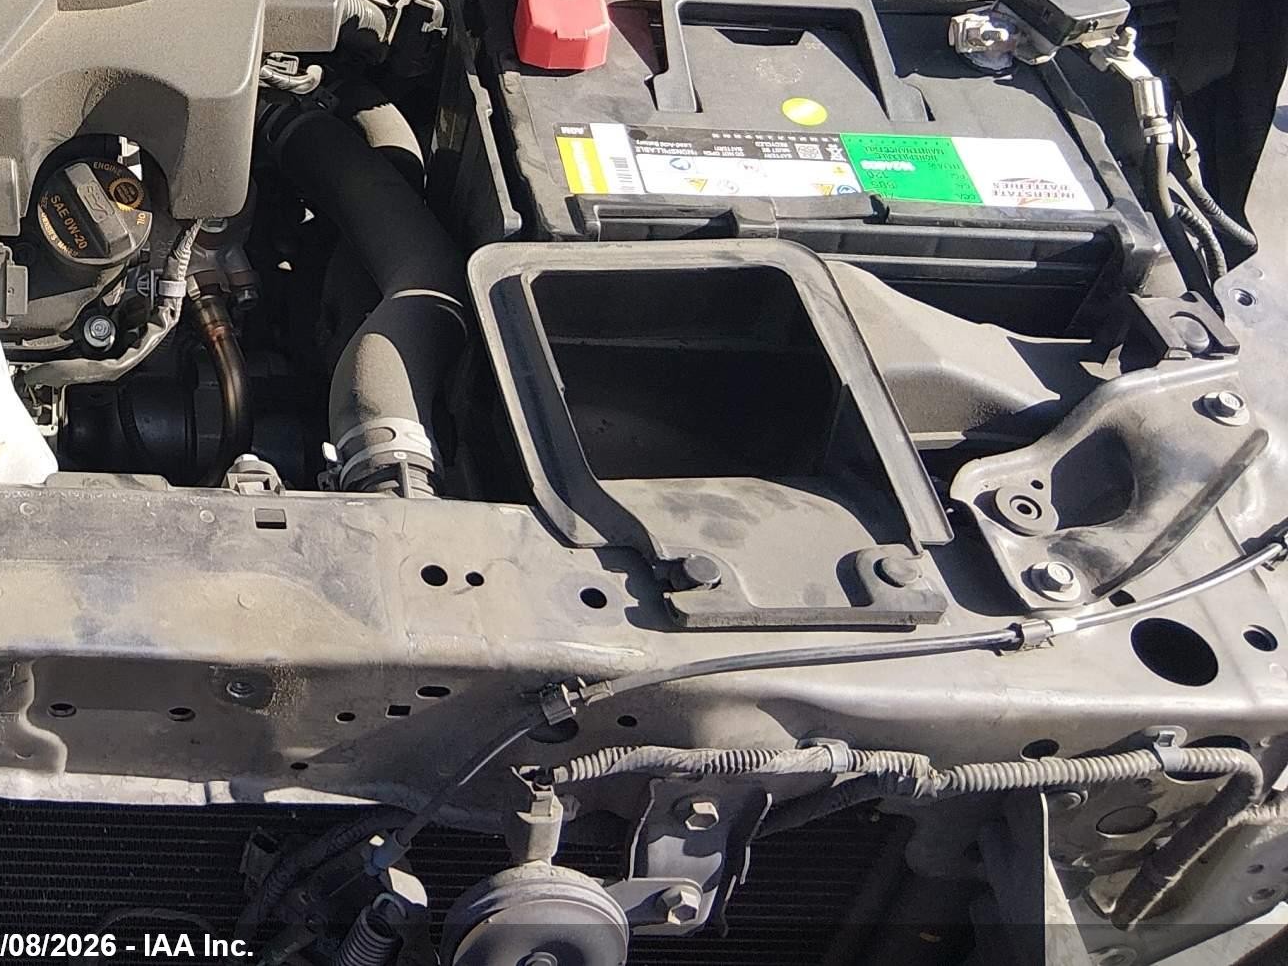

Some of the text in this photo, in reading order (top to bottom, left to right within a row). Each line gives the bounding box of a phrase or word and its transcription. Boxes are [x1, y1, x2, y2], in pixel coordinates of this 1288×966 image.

[992, 182, 1069, 192] BATTERIES
[991, 189, 1075, 201] INTERSTATE
[50, 194, 88, 250] SAE 0W-20
[136, 212, 146, 226] OIL
